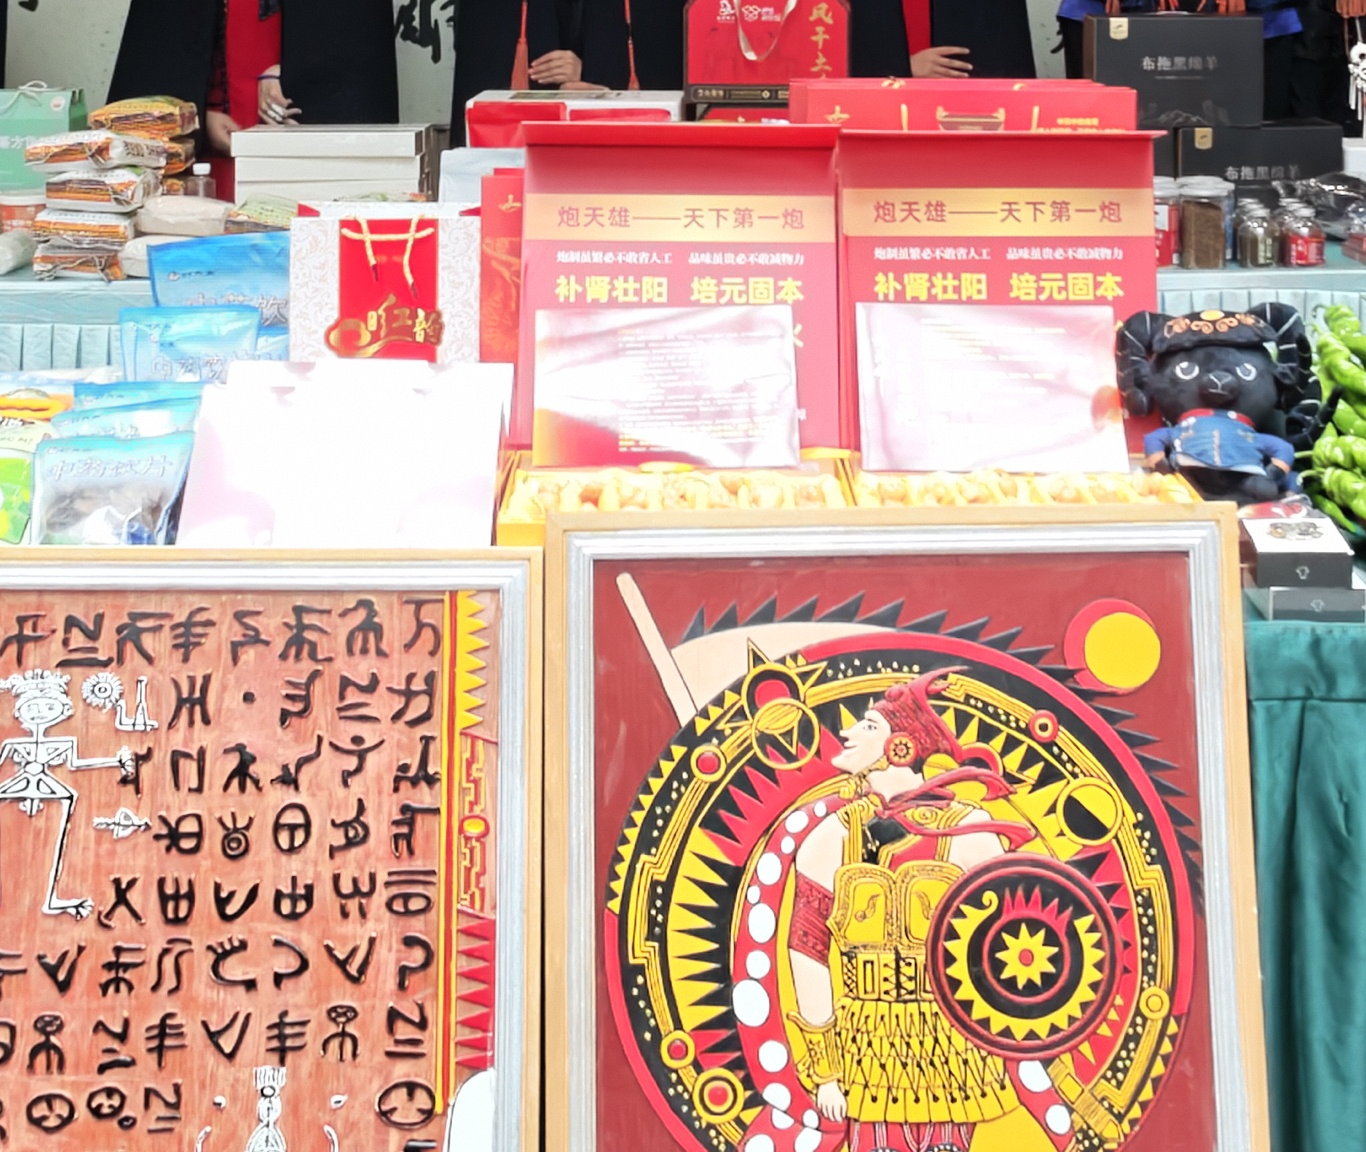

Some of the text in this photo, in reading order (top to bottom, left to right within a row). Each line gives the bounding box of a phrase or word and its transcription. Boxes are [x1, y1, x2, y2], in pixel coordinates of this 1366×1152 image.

[809, 2, 834, 81] 风干土
[555, 275, 805, 305] 补肾壮阳 培元固本
[874, 272, 1125, 302] 补肾壮阳 培元固本
